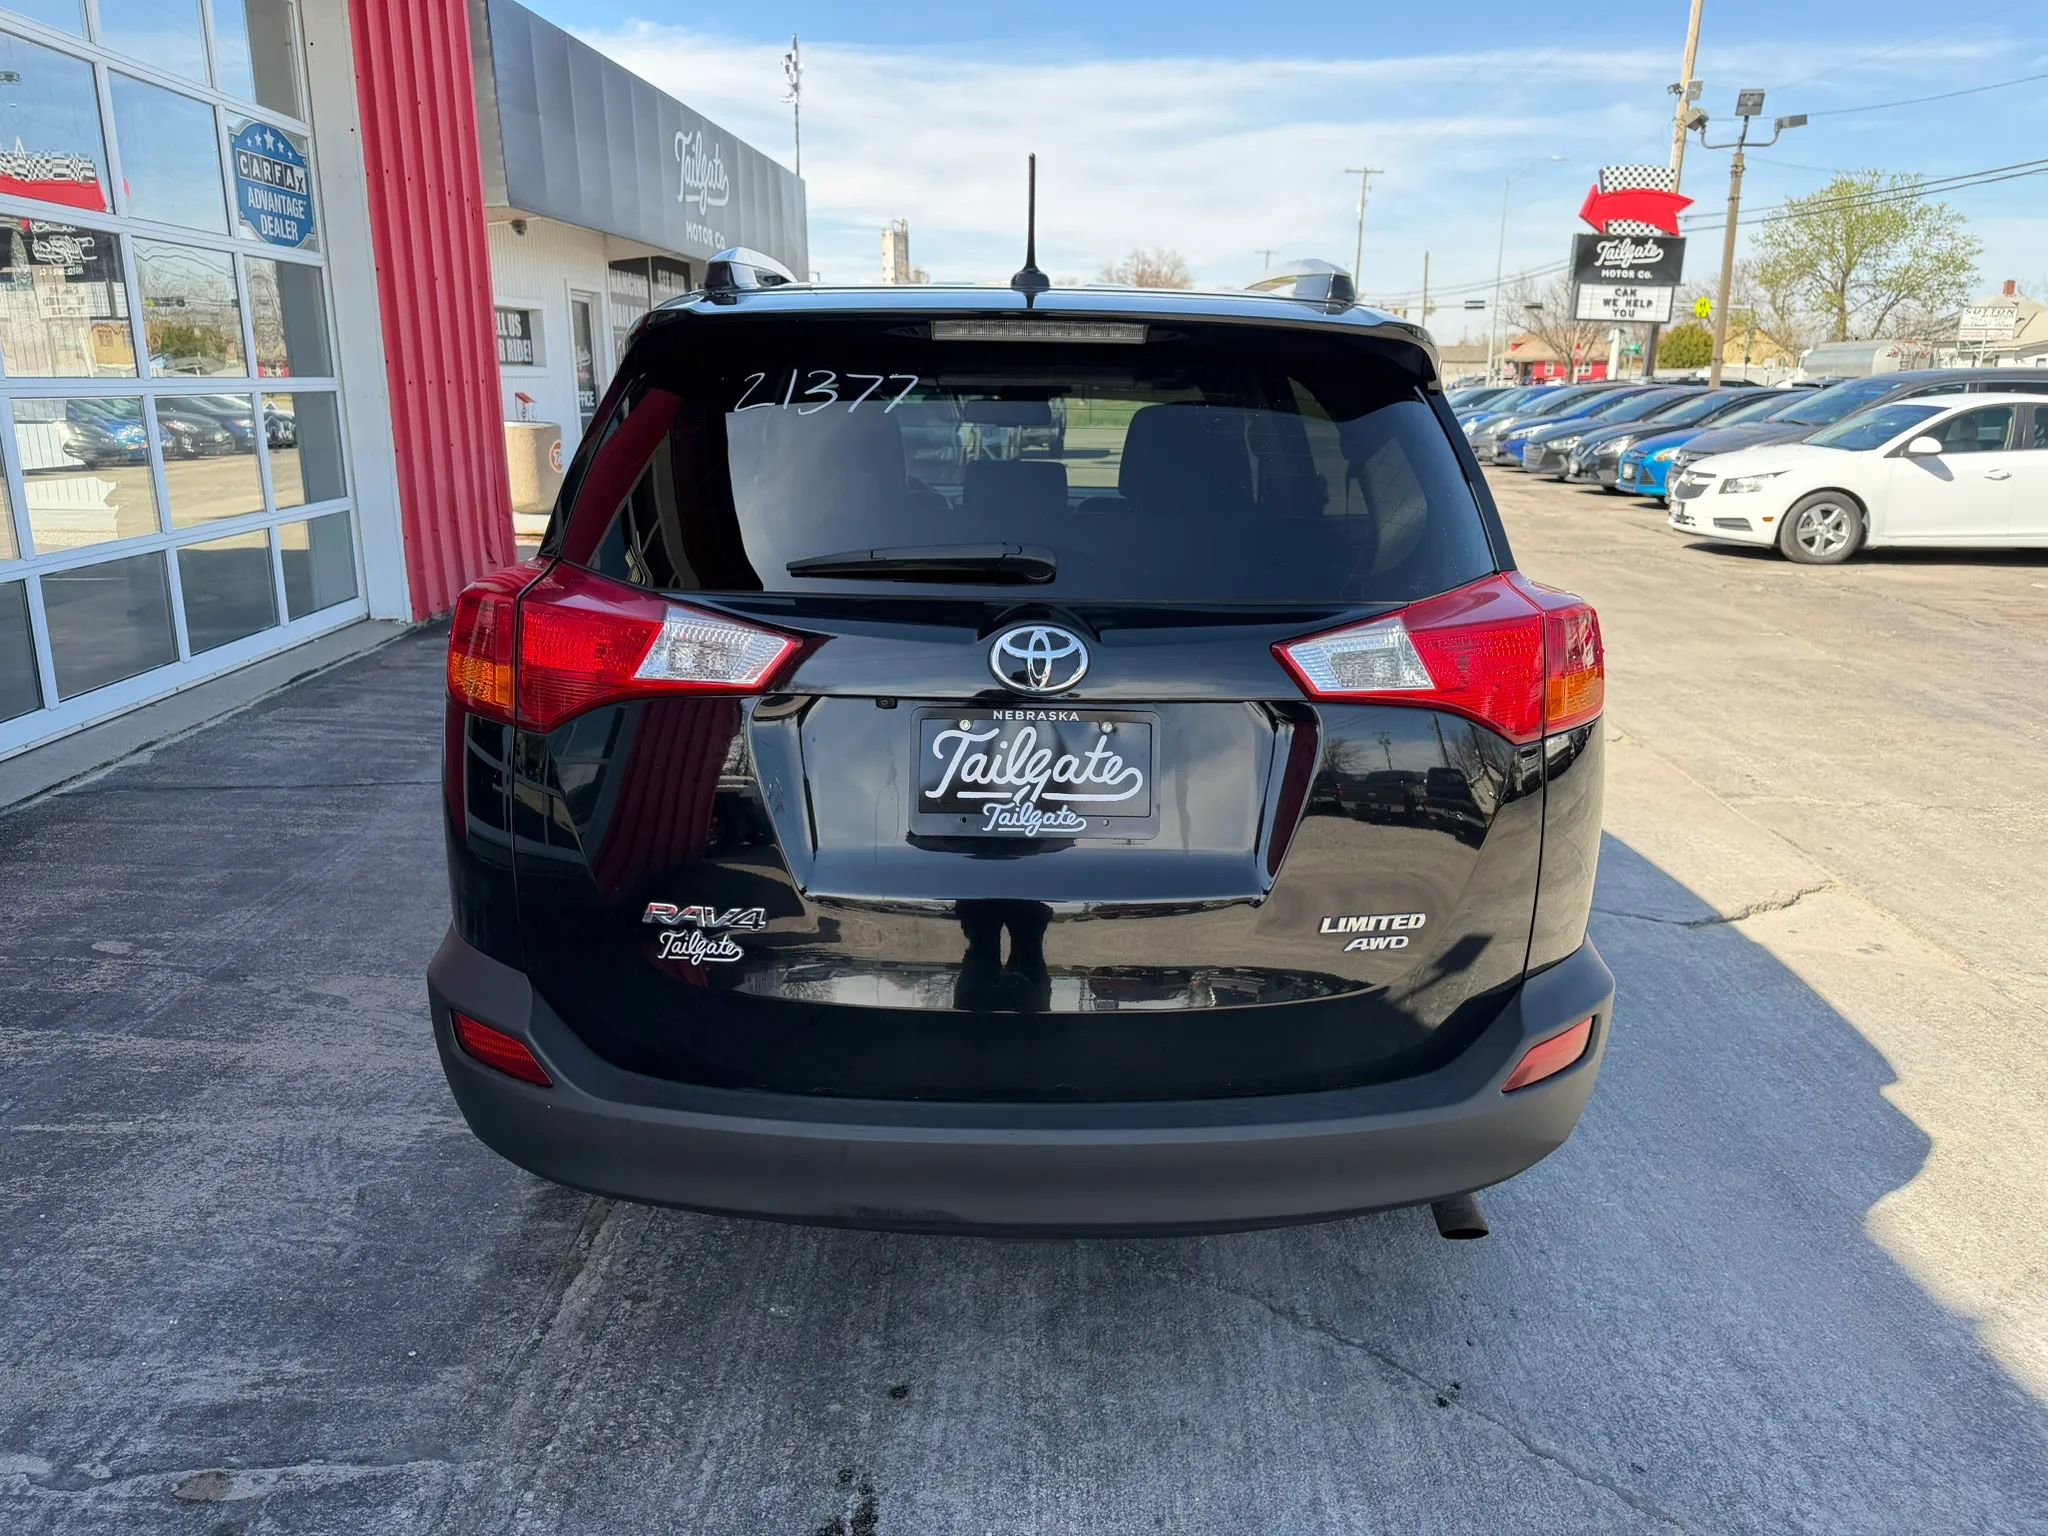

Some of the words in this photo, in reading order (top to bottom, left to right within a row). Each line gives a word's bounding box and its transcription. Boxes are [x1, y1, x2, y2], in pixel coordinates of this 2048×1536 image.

[238, 153, 305, 193] CARFAX
[674, 130, 730, 216] Tailgate
[247, 186, 305, 219] ADVANTAGE
[260, 213, 299, 241] DEALER
[686, 220, 713, 246] MOTOR
[1594, 237, 1665, 268] Tailgate
[1601, 268, 1635, 278] MOTOR
[1602, 298, 1619, 307] WE
[1625, 299, 1653, 308] HELP
[1614, 288, 1637, 297] CAN
[507, 313, 522, 337] US
[1612, 309, 1636, 317] YOU
[506, 339, 533, 362] RIDE!
[733, 368, 919, 416] 21377
[993, 710, 1080, 722] NEBRASKA
[925, 726, 1144, 804] Tailgate
[982, 802, 1087, 837] Tailgate
[642, 902, 767, 931] RAV4
[1319, 912, 1426, 934] LIMITED
[657, 930, 744, 965] Tailgate
[1343, 935, 1410, 952] AWD
